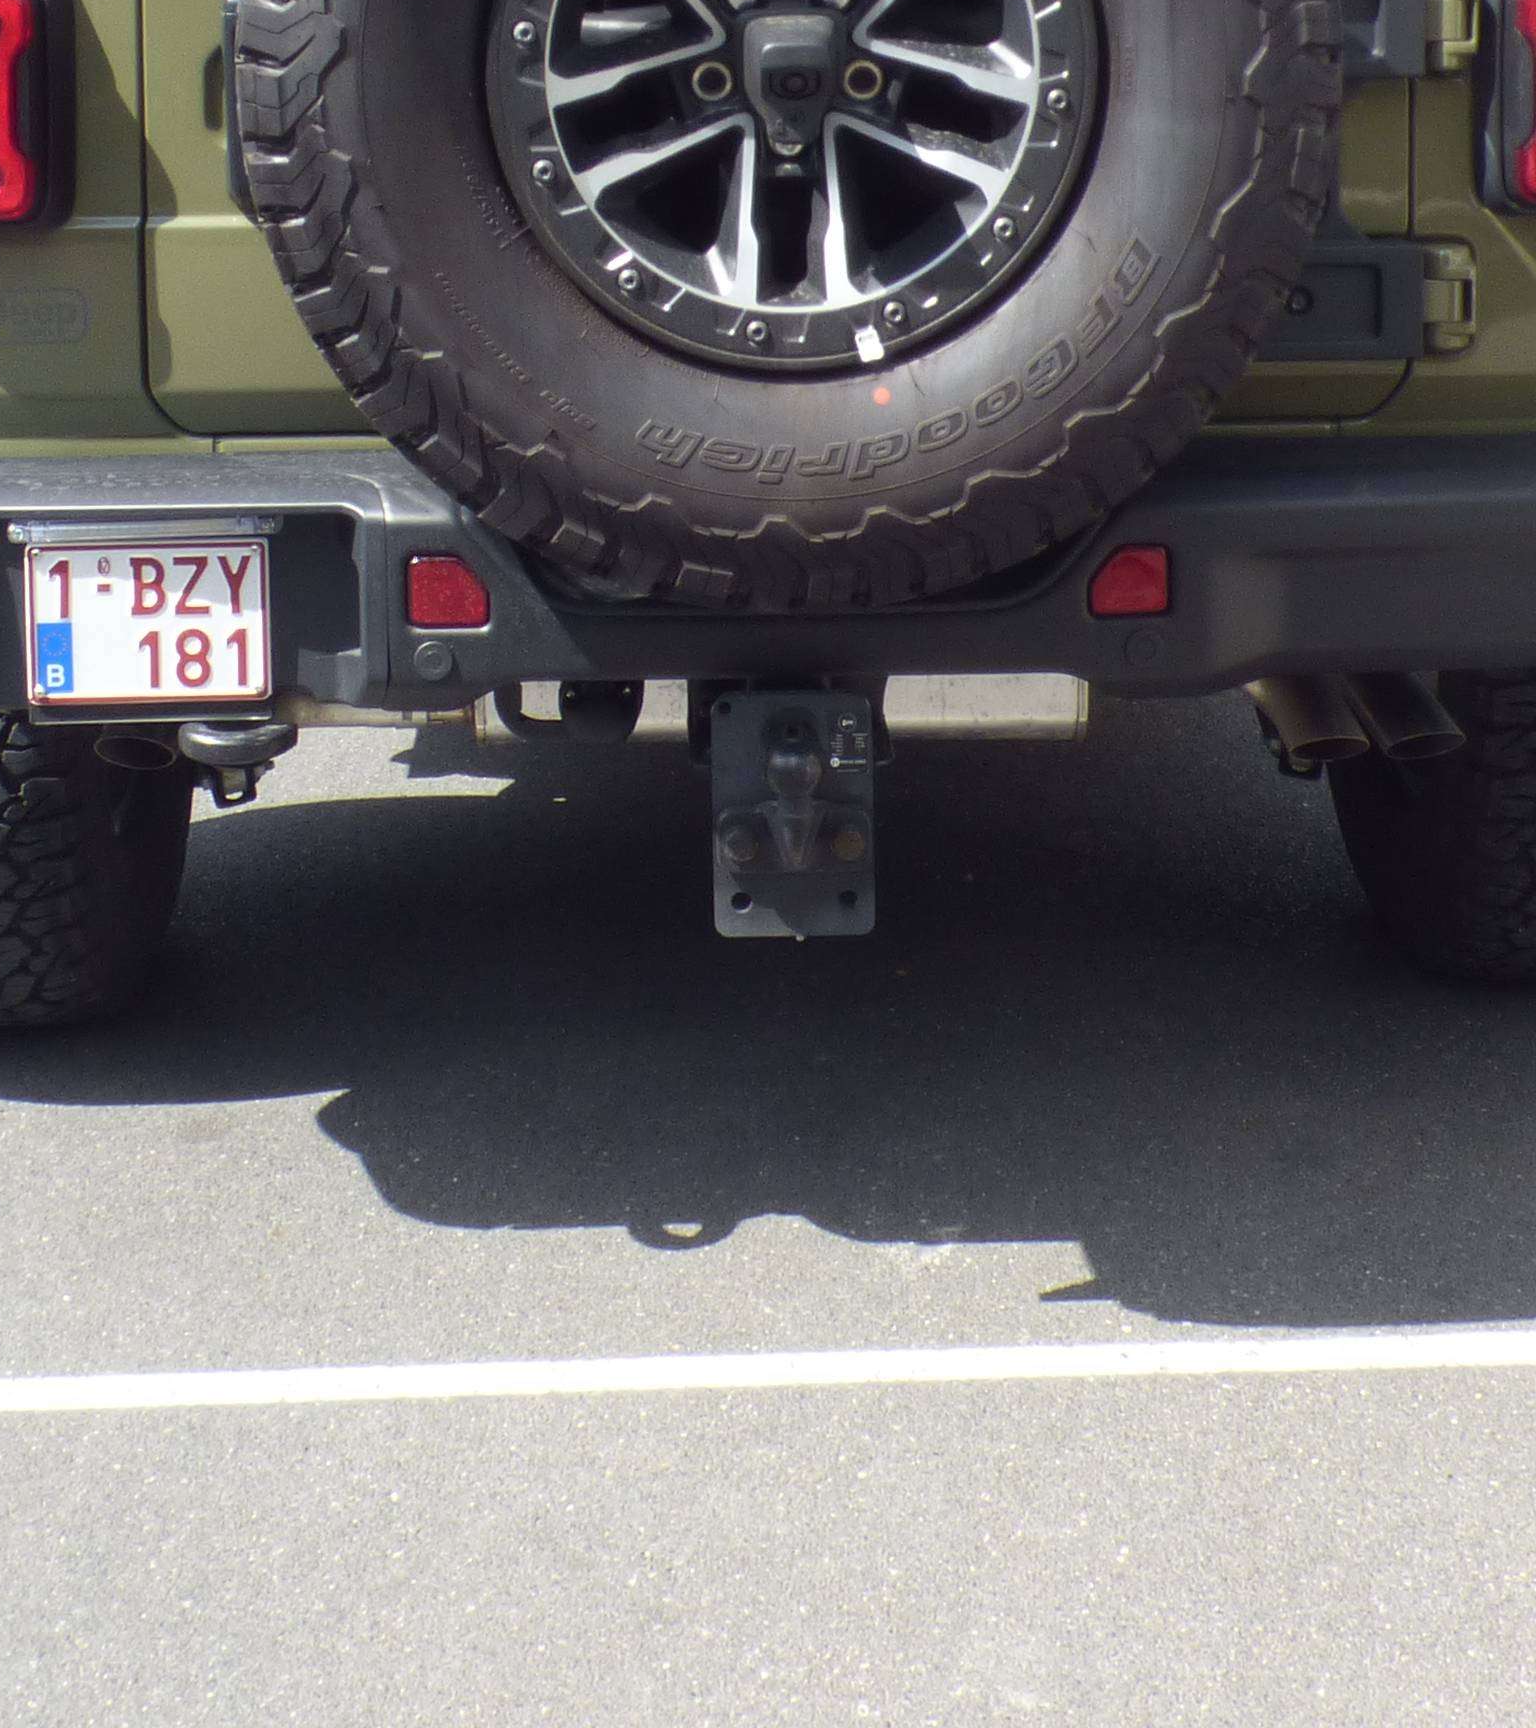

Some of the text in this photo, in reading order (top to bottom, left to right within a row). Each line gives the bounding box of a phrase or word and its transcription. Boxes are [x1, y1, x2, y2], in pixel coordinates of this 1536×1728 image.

[633, 237, 1162, 485] BFGoodrich
[46, 663, 65, 688] B
[138, 628, 248, 689] 181
